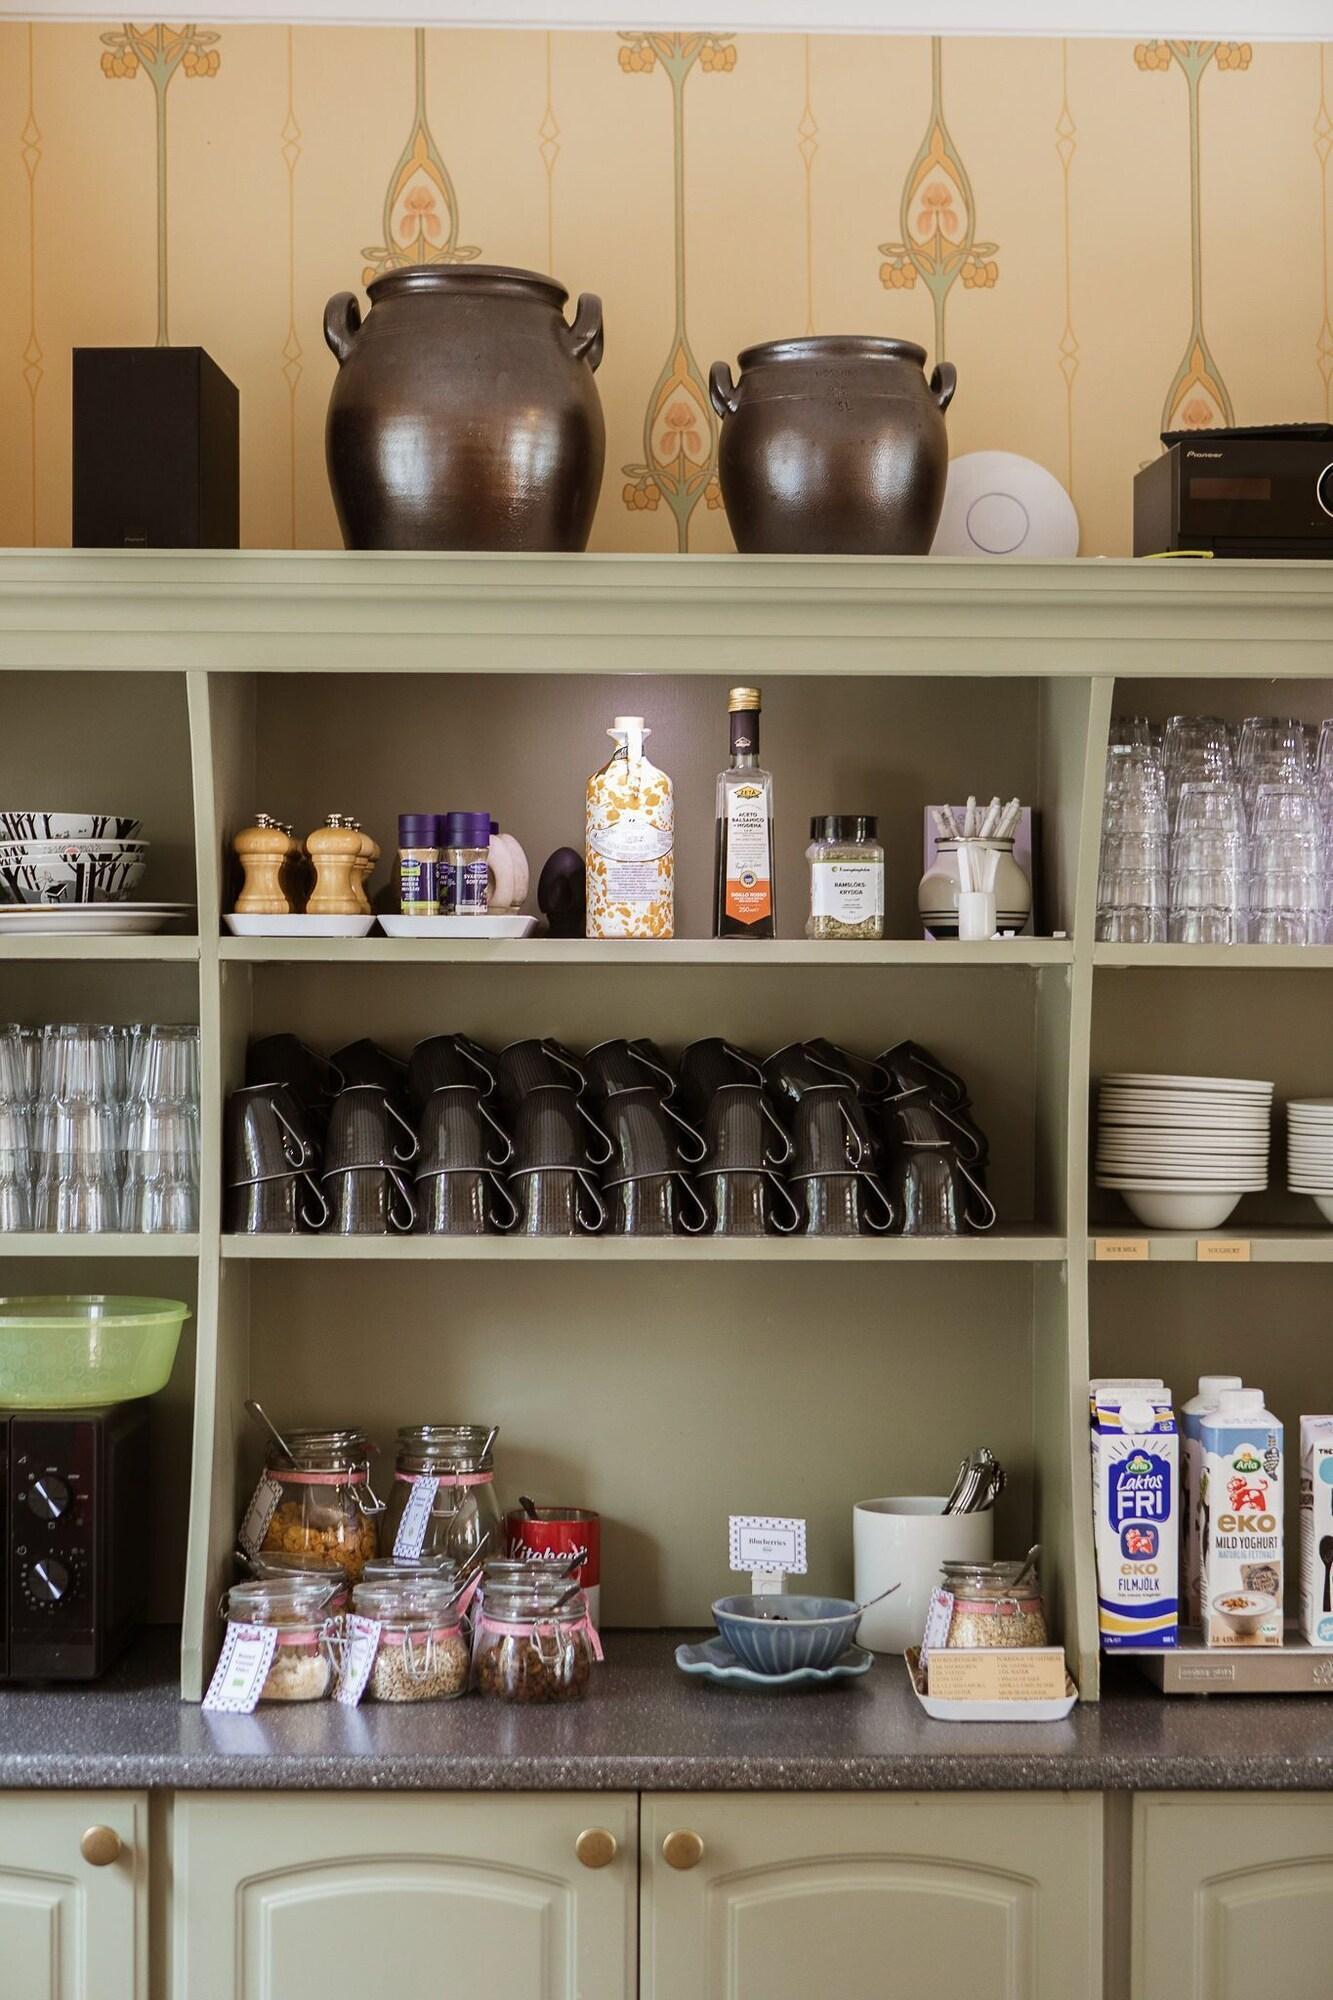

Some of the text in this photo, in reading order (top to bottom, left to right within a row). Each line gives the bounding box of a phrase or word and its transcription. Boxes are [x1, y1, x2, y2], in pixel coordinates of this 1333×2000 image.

[1186, 450, 1224, 459] Pioneer
[1129, 1462, 1149, 1471] Arla
[1235, 1460, 1259, 1470] Arla
[1116, 1472, 1164, 1491] Laktos
[1117, 1490, 1163, 1520] FRI
[1217, 1514, 1277, 1533] eko
[748, 1537, 786, 1546] Blueberries
[1215, 1536, 1278, 1549] MILD YOGHURT
[1120, 1563, 1158, 1576] eko
[1118, 1577, 1160, 1591] FILMJÖLK
